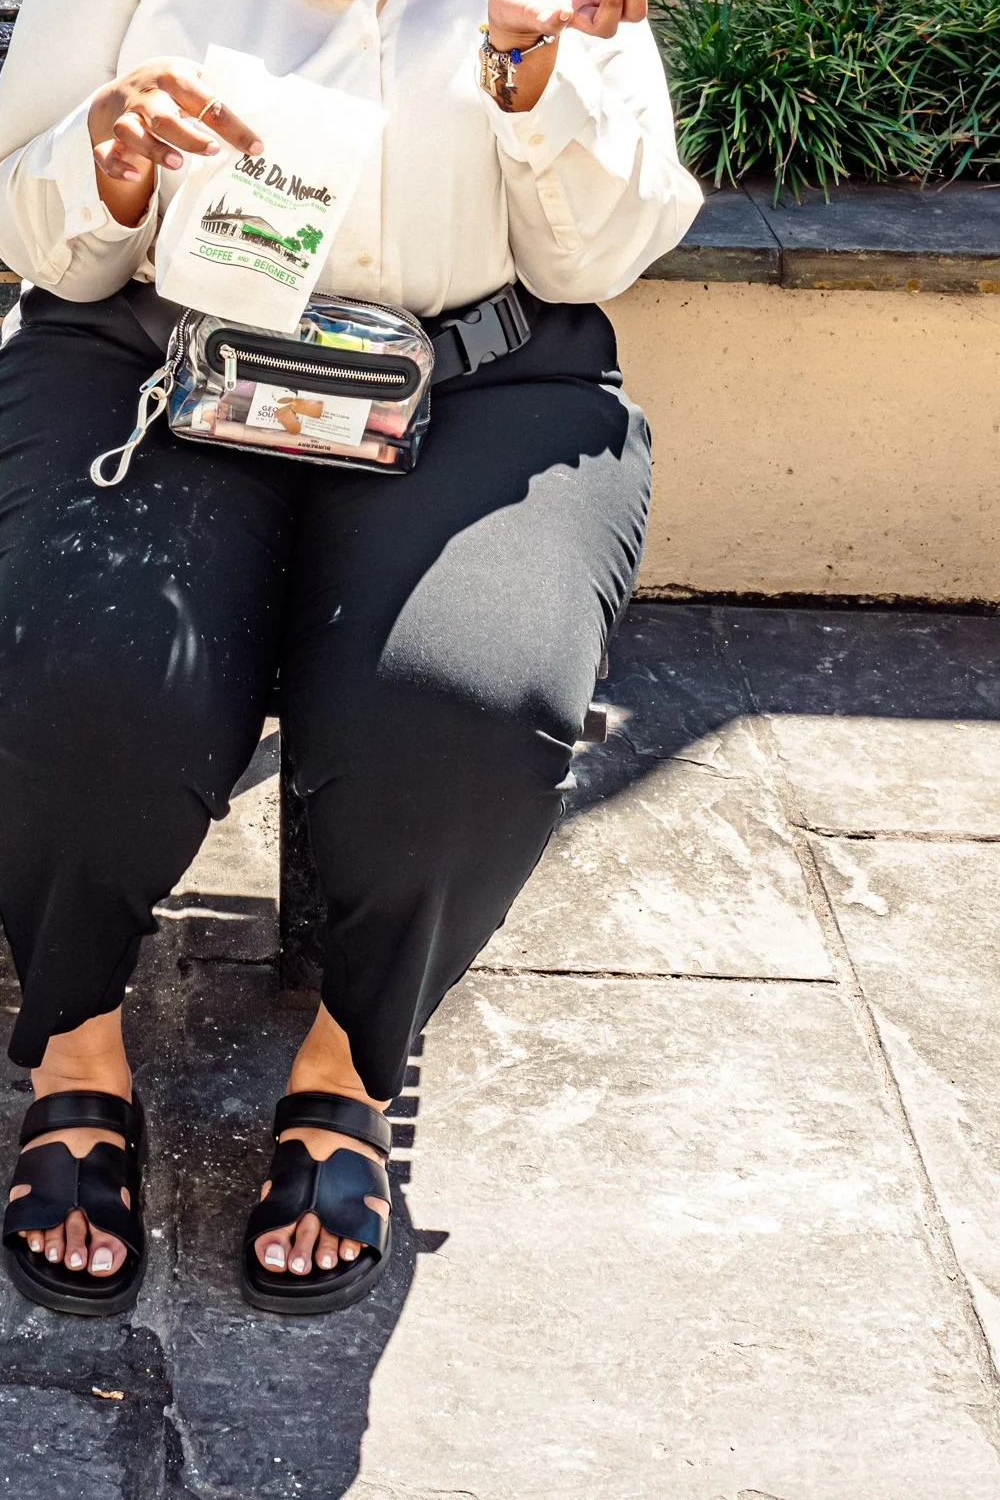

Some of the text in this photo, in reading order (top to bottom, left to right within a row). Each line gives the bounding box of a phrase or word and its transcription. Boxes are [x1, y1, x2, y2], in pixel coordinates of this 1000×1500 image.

[235, 153, 331, 206] Café Du Monde
[199, 245, 297, 285] COFFEE AND BEIGNETS
[257, 410, 275, 418] SOU
[297, 442, 331, 451] BURBERRY
